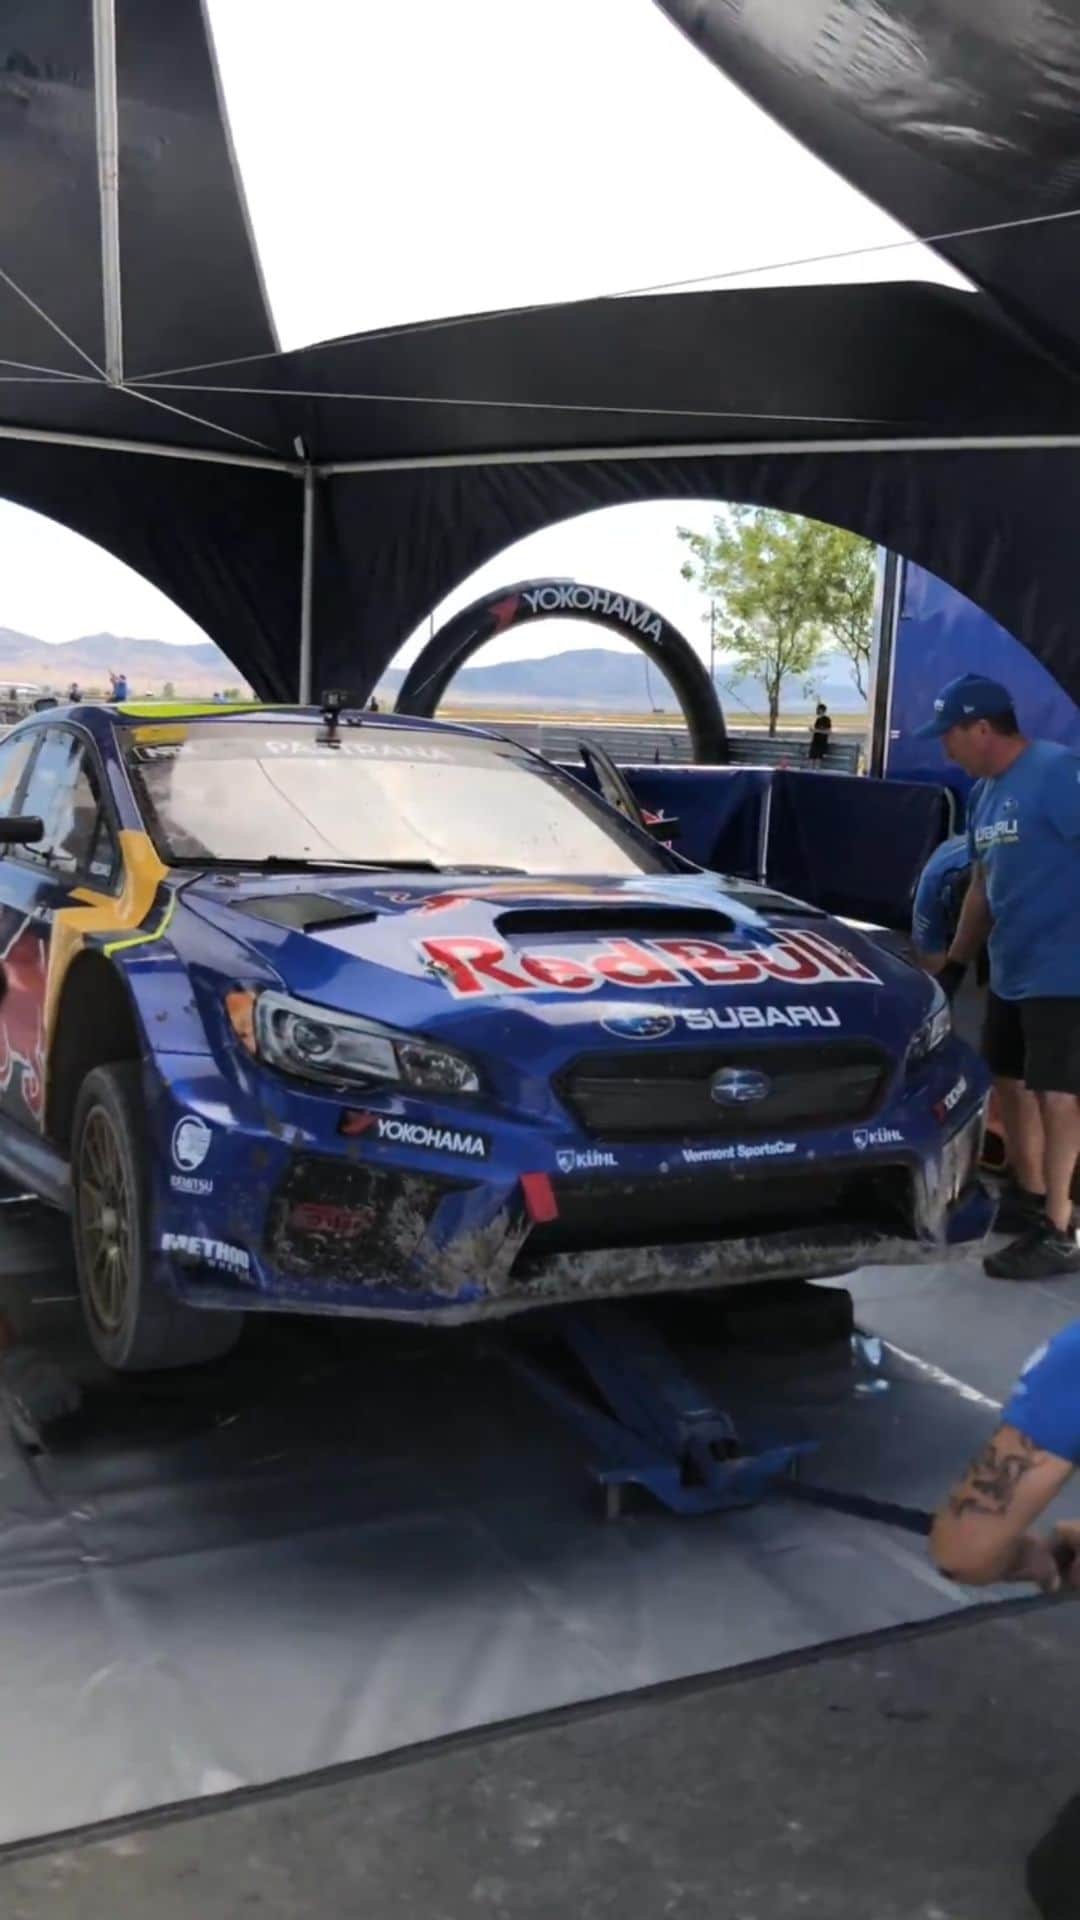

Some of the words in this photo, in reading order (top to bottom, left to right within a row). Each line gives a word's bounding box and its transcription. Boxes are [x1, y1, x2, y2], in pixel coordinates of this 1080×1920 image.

[522, 586, 664, 643] YOKOHAMA
[417, 935, 691, 997] Red
[645, 929, 884, 985] Bull
[685, 1006, 841, 1029] SUBARU
[377, 1118, 486, 1156] YOKOHAMA
[682, 1148, 735, 1163] Vermont
[737, 1140, 798, 1159] SportsCar
[161, 1232, 249, 1269] METHOD
